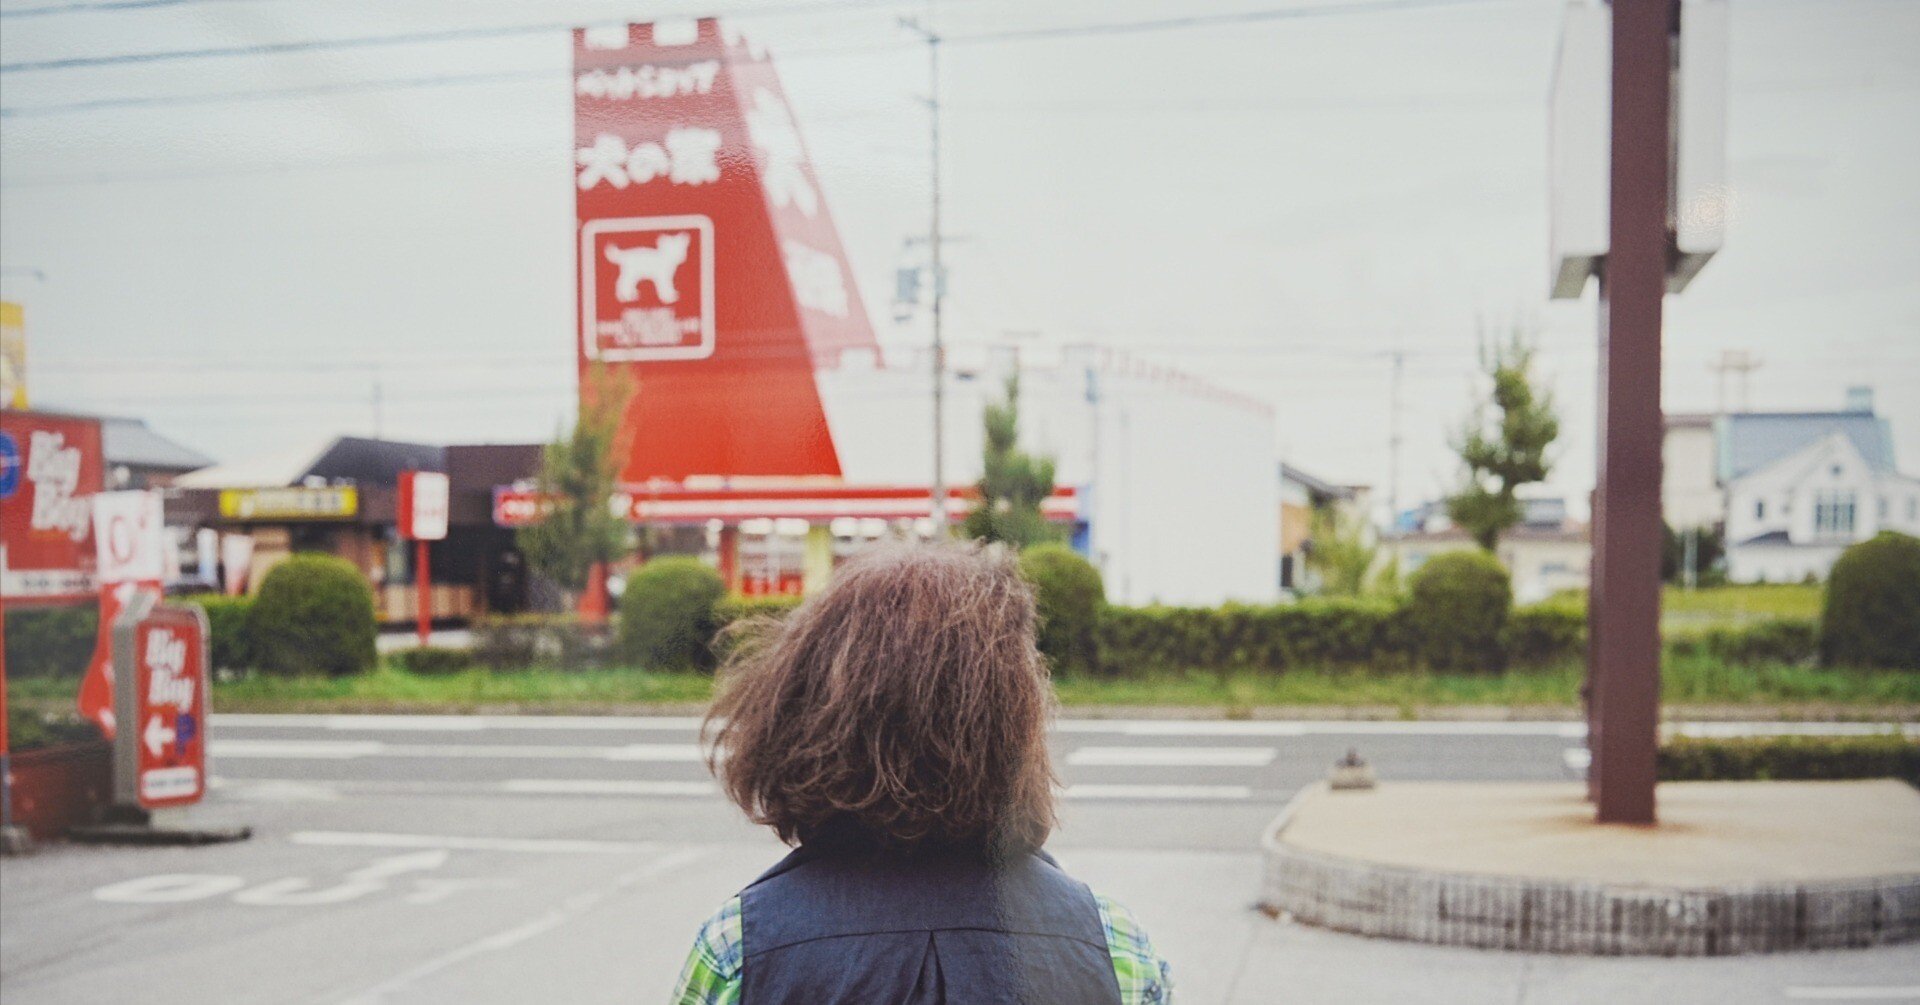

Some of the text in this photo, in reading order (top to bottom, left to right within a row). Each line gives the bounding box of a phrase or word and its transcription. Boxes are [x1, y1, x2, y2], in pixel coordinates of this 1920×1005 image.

[27, 430, 81, 496] Big
[32, 484, 93, 541] Boy
[145, 628, 186, 676] Big
[149, 670, 195, 714] Boy
